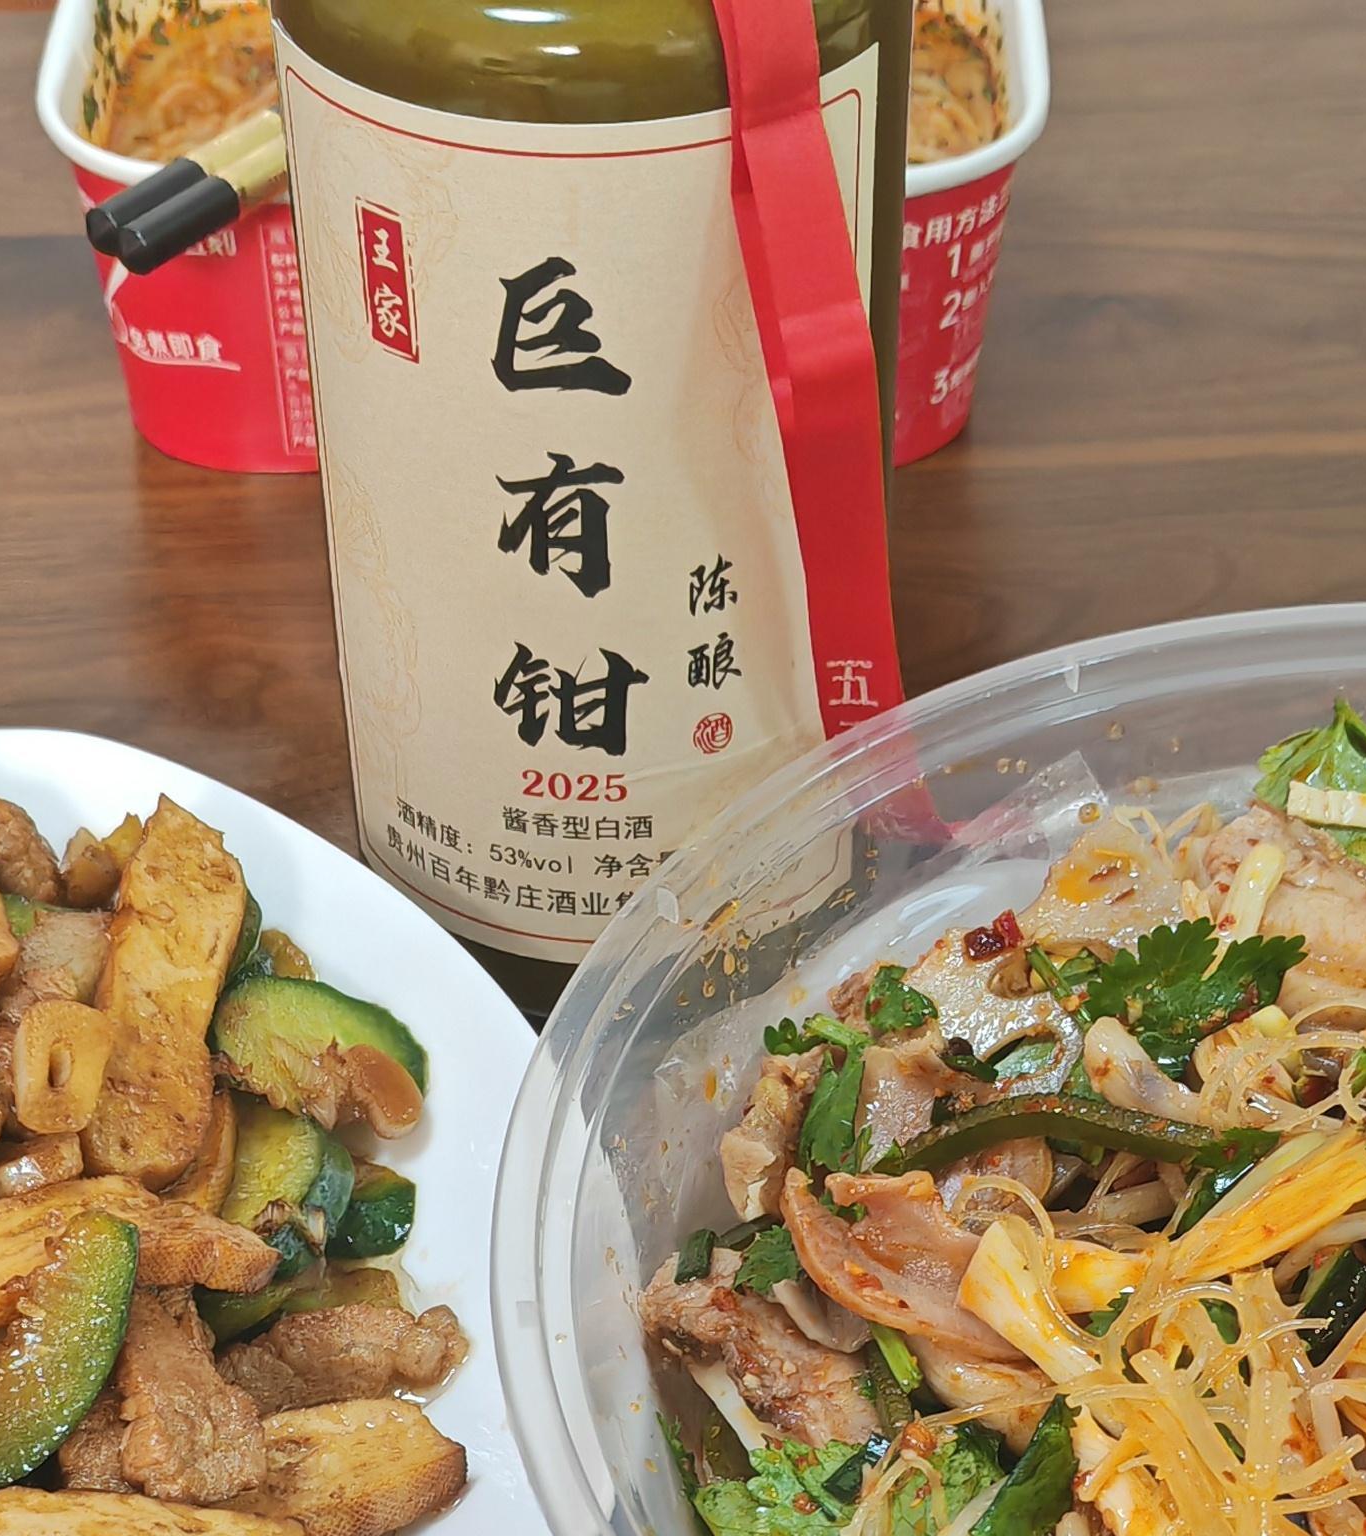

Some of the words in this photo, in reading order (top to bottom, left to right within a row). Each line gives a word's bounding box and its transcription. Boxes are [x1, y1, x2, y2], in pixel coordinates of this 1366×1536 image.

[947, 243, 962, 279] 1
[371, 226, 411, 339] 王家
[939, 289, 962, 331] 2
[688, 553, 742, 690] 陈酿
[521, 768, 628, 802] 2025
[502, 805, 653, 840] 酱香型白酒
[489, 844, 573, 875] 53%vol
